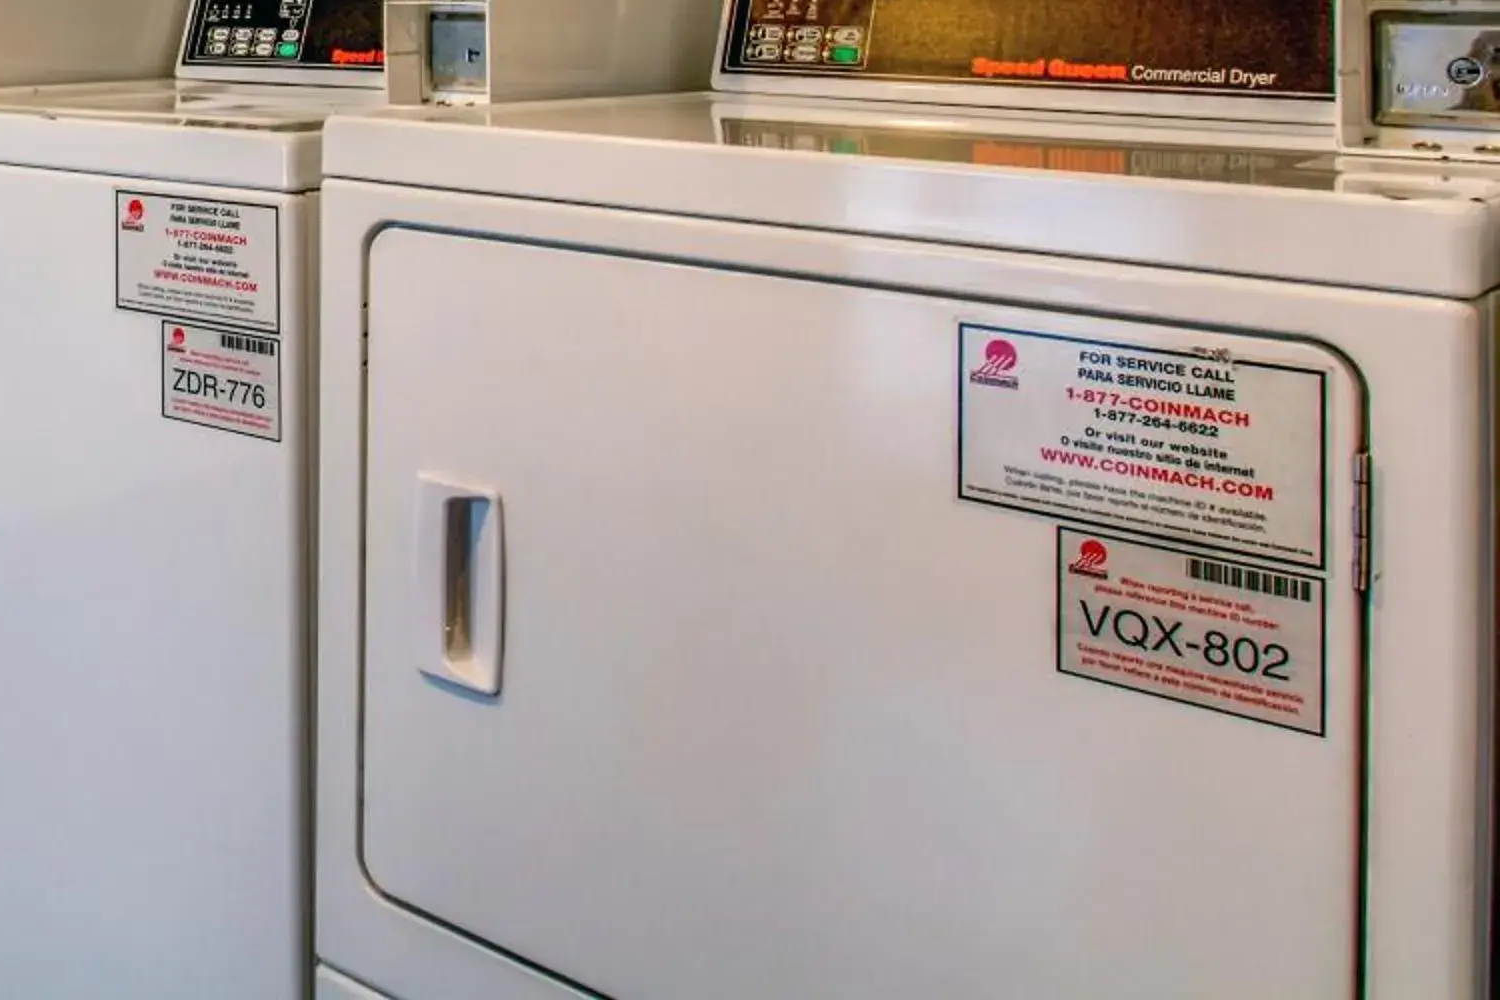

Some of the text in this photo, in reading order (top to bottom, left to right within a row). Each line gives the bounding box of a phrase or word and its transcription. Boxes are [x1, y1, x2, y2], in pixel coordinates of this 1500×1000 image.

[1132, 65, 1277, 88] Commercial Dryer
[1078, 368, 1235, 401] PARA SERVICIO LLAME
[1080, 351, 1235, 383] FOR SERVICE CALL
[173, 367, 265, 408] ZDR-776
[1066, 387, 1249, 427] 1-877-COINMACH
[1094, 408, 1219, 437] 1-877-264-6622
[1060, 435, 1070, 446] O
[1185, 457, 1201, 469] de
[1203, 460, 1255, 478] internet
[1085, 427, 1228, 458] Or visit our website
[1041, 447, 1273, 501] WWW.COINMACH.COM
[1080, 599, 1290, 681] VQX-802
